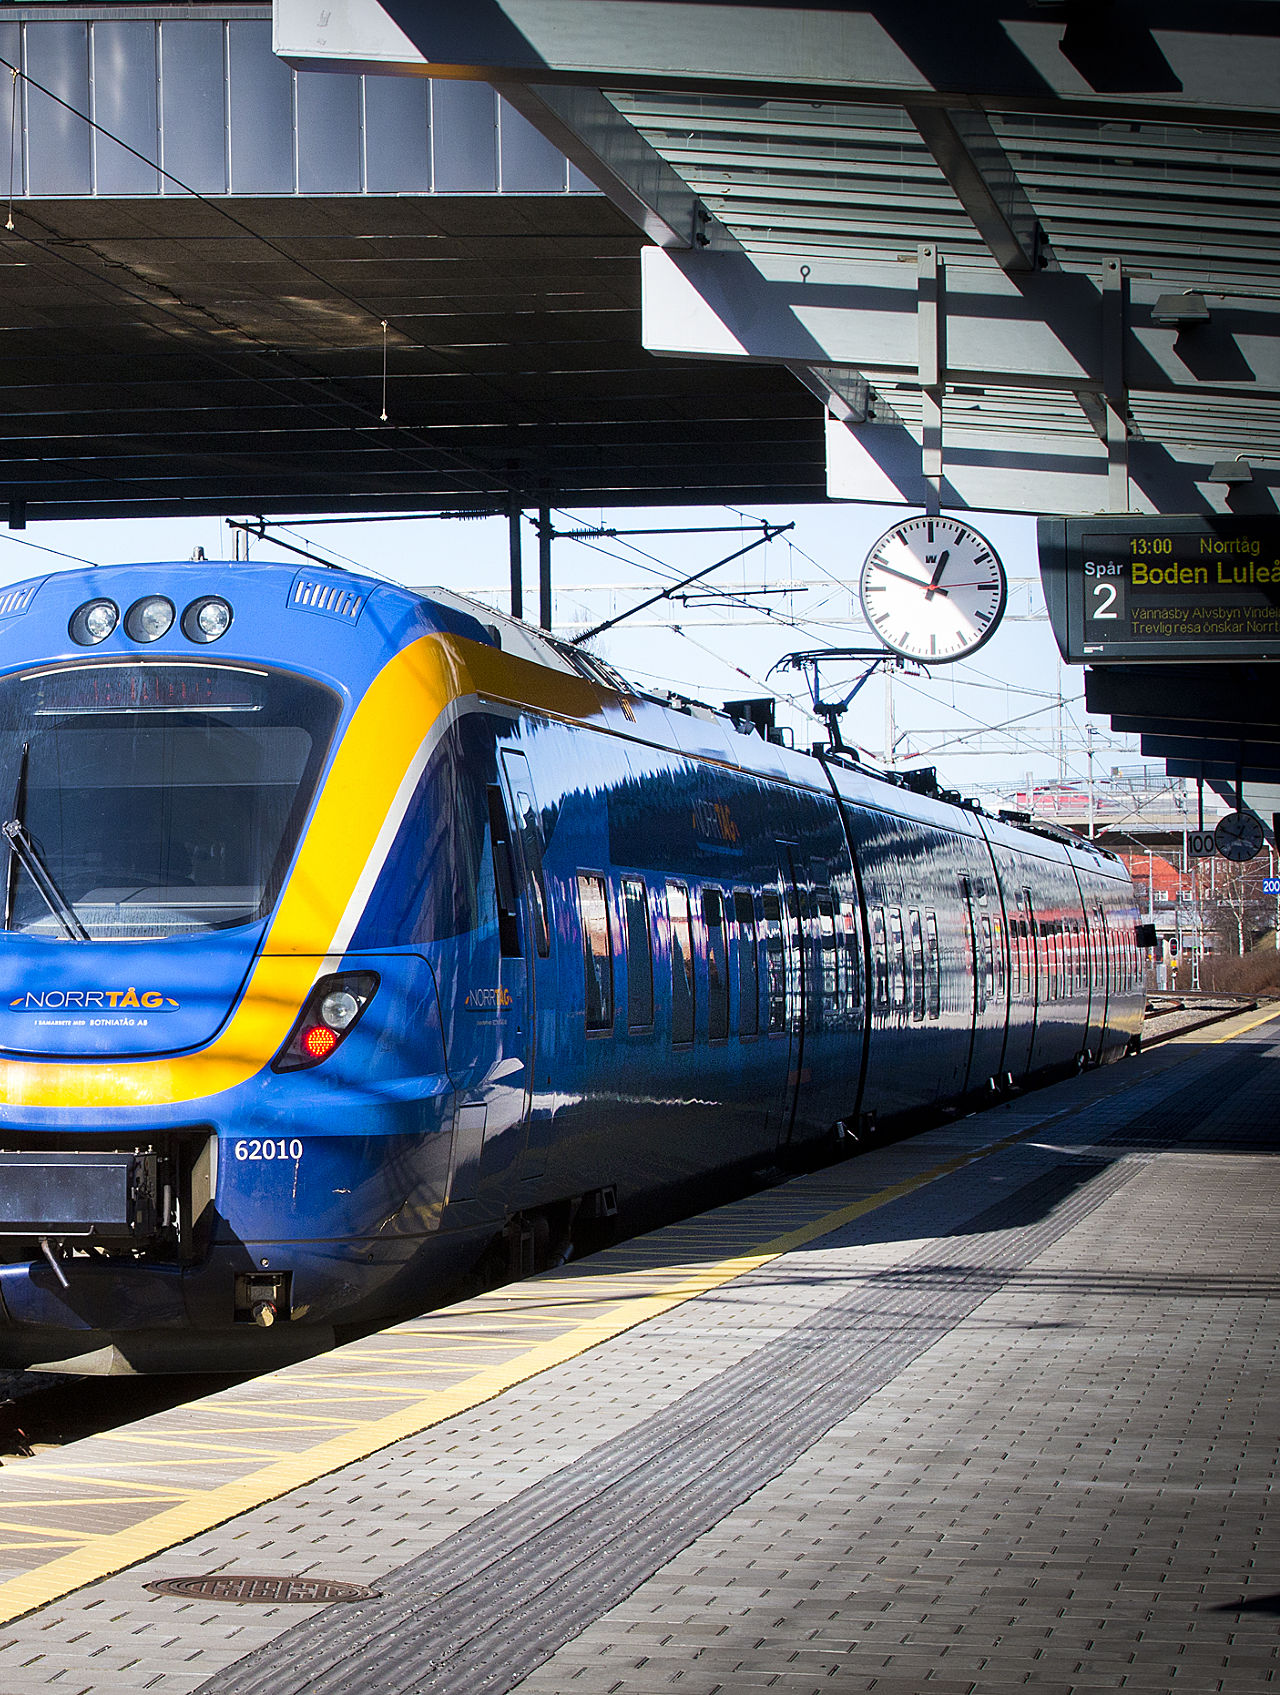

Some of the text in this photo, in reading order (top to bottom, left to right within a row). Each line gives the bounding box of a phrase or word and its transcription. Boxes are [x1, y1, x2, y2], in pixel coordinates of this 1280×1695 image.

[1130, 536, 1261, 556] 13:00 Norrtåg
[1084, 561, 1124, 578] Spår
[1131, 559, 1280, 584] Boden Luleå
[1093, 583, 1118, 620] 2
[1131, 621, 1172, 636] Trevlig
[1174, 624, 1201, 633] resa
[1247, 620, 1280, 633] Norrt
[1188, 835, 1214, 853] 100
[1263, 880, 1280, 892] 200
[25, 987, 164, 1008] NORRTÅG
[89, 1017, 135, 1026] BOTNIATÅG
[234, 1139, 302, 1160] 62010
